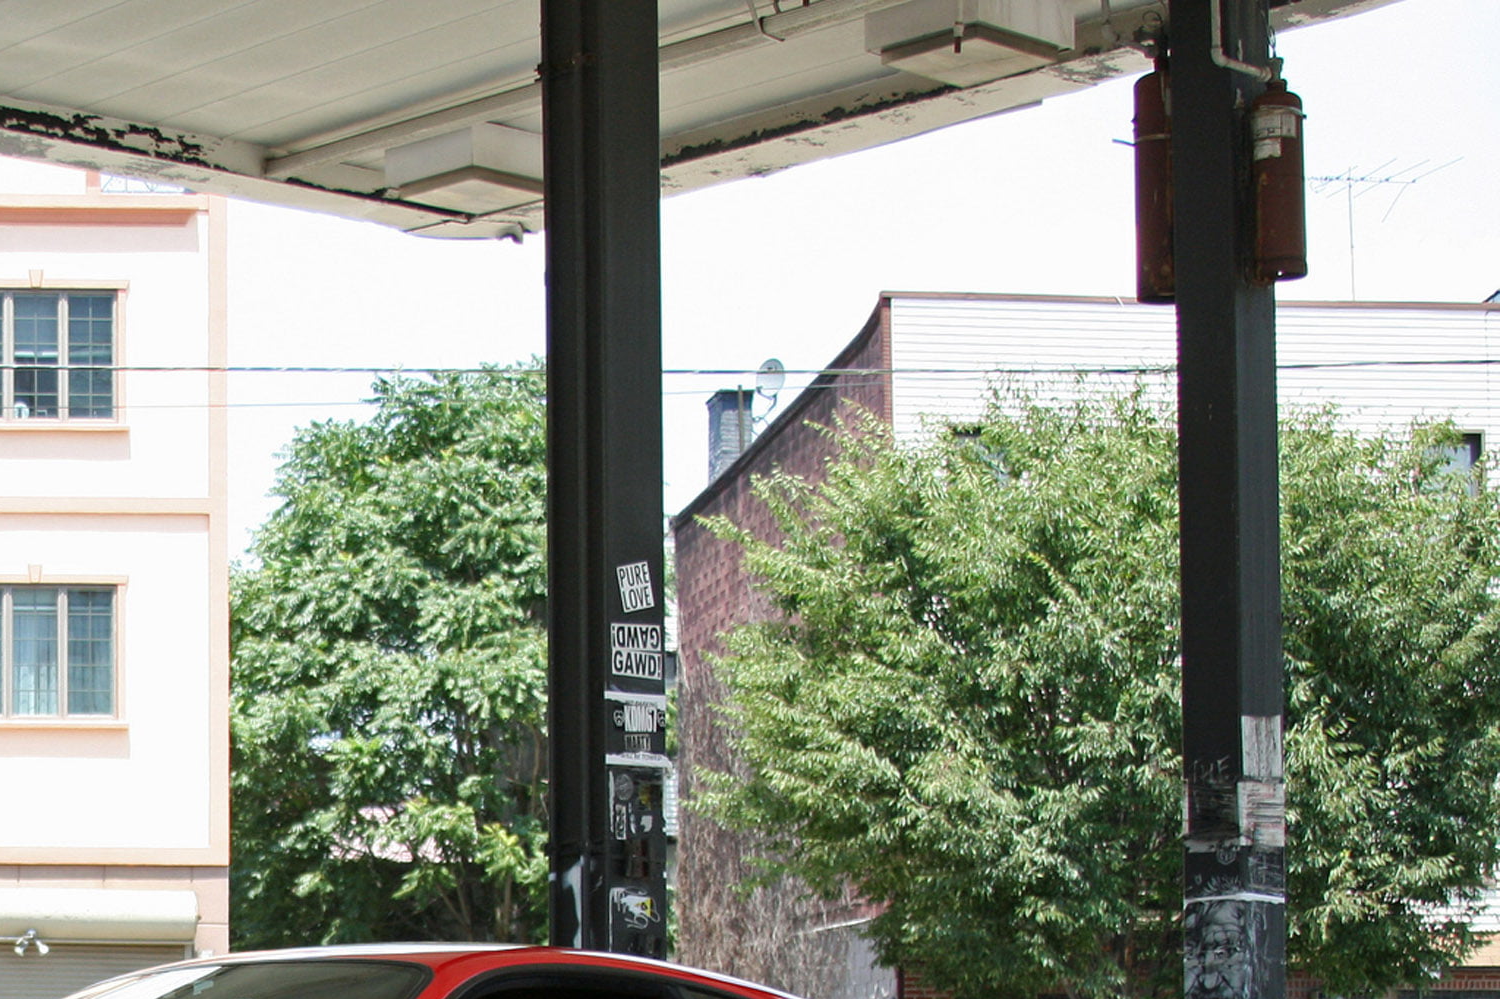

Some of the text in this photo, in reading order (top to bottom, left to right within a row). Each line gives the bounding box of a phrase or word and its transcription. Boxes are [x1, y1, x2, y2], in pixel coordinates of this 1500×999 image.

[618, 563, 650, 588] PURE
[622, 586, 652, 610] LOVE
[611, 625, 660, 649] GAWD!
[613, 650, 661, 678] GAWD!
